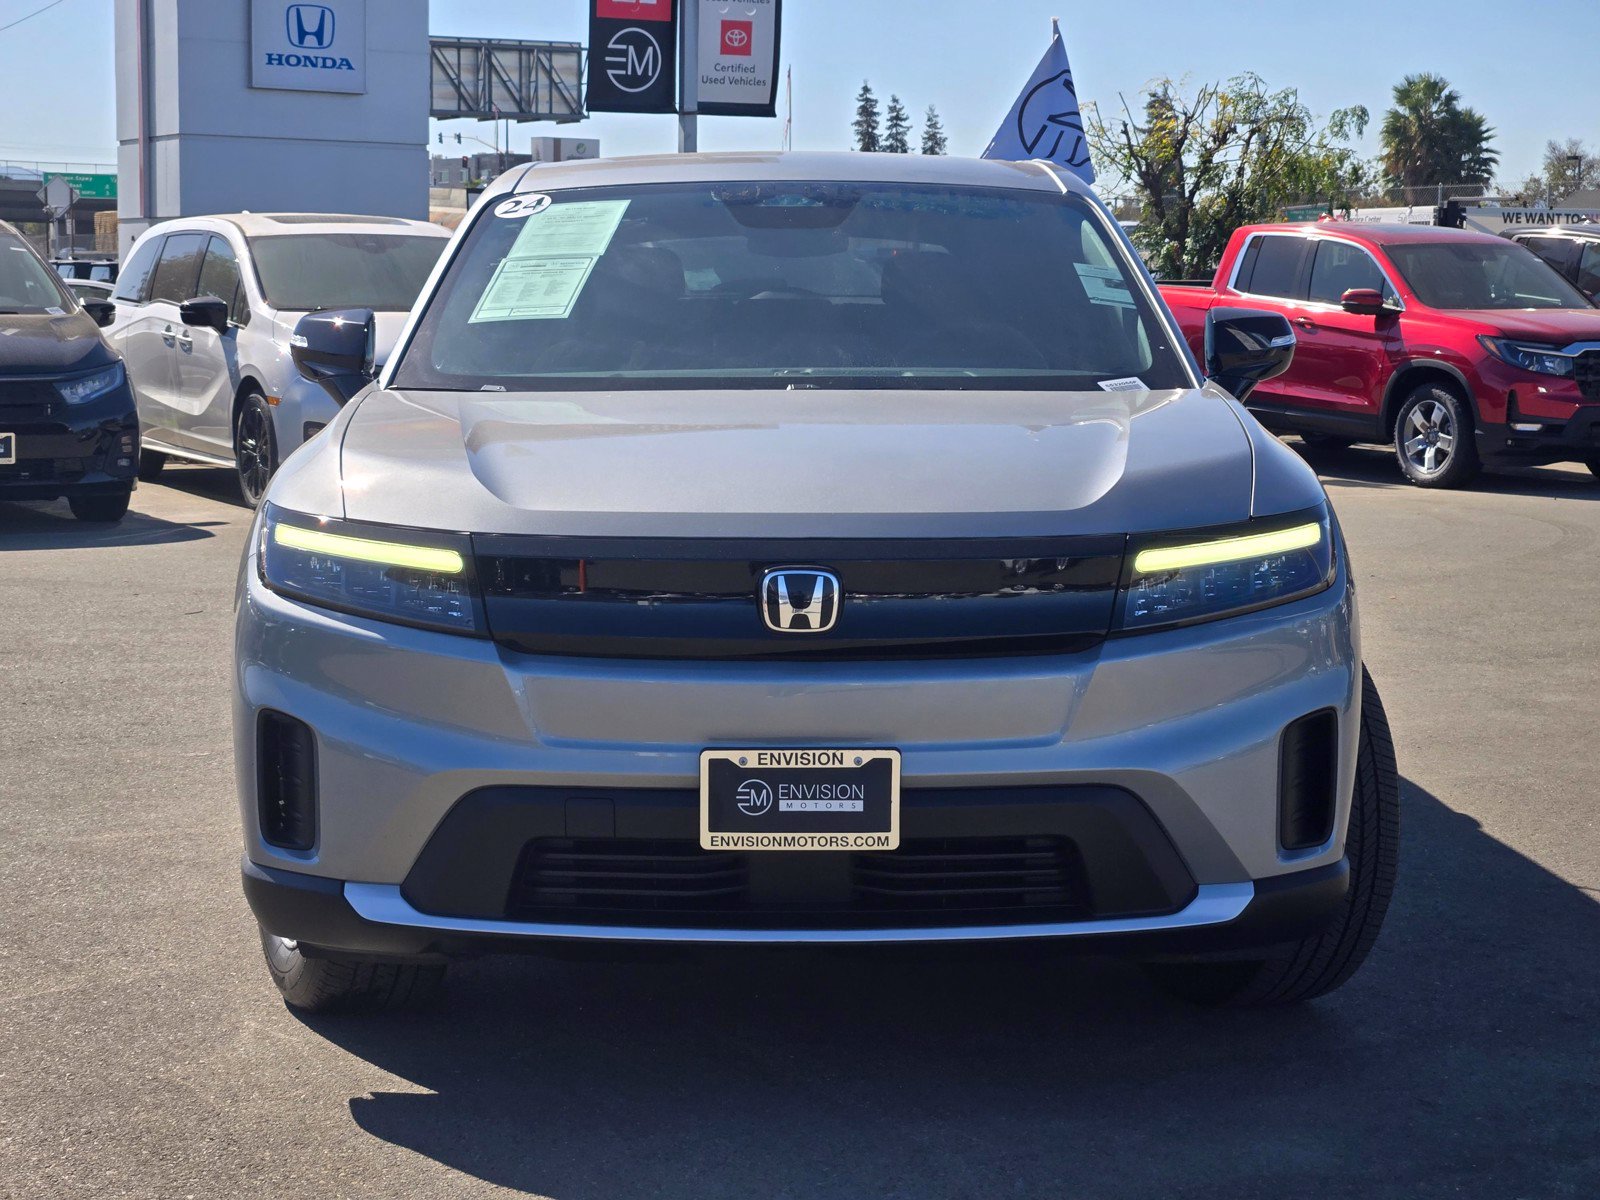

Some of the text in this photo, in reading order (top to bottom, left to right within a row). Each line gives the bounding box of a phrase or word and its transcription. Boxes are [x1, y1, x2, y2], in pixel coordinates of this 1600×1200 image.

[265, 53, 355, 71] HONDA
[714, 63, 756, 74] Certified
[701, 75, 767, 87] Used Vehicles
[500, 197, 546, 215] 24
[1502, 212, 1521, 224] WE
[1524, 212, 1562, 225] WANT
[1564, 213, 1580, 224] TO
[757, 752, 844, 766] ENVISION
[778, 784, 864, 800] ENVISION
[710, 835, 890, 848] ENVISIONMOTORS.COM
